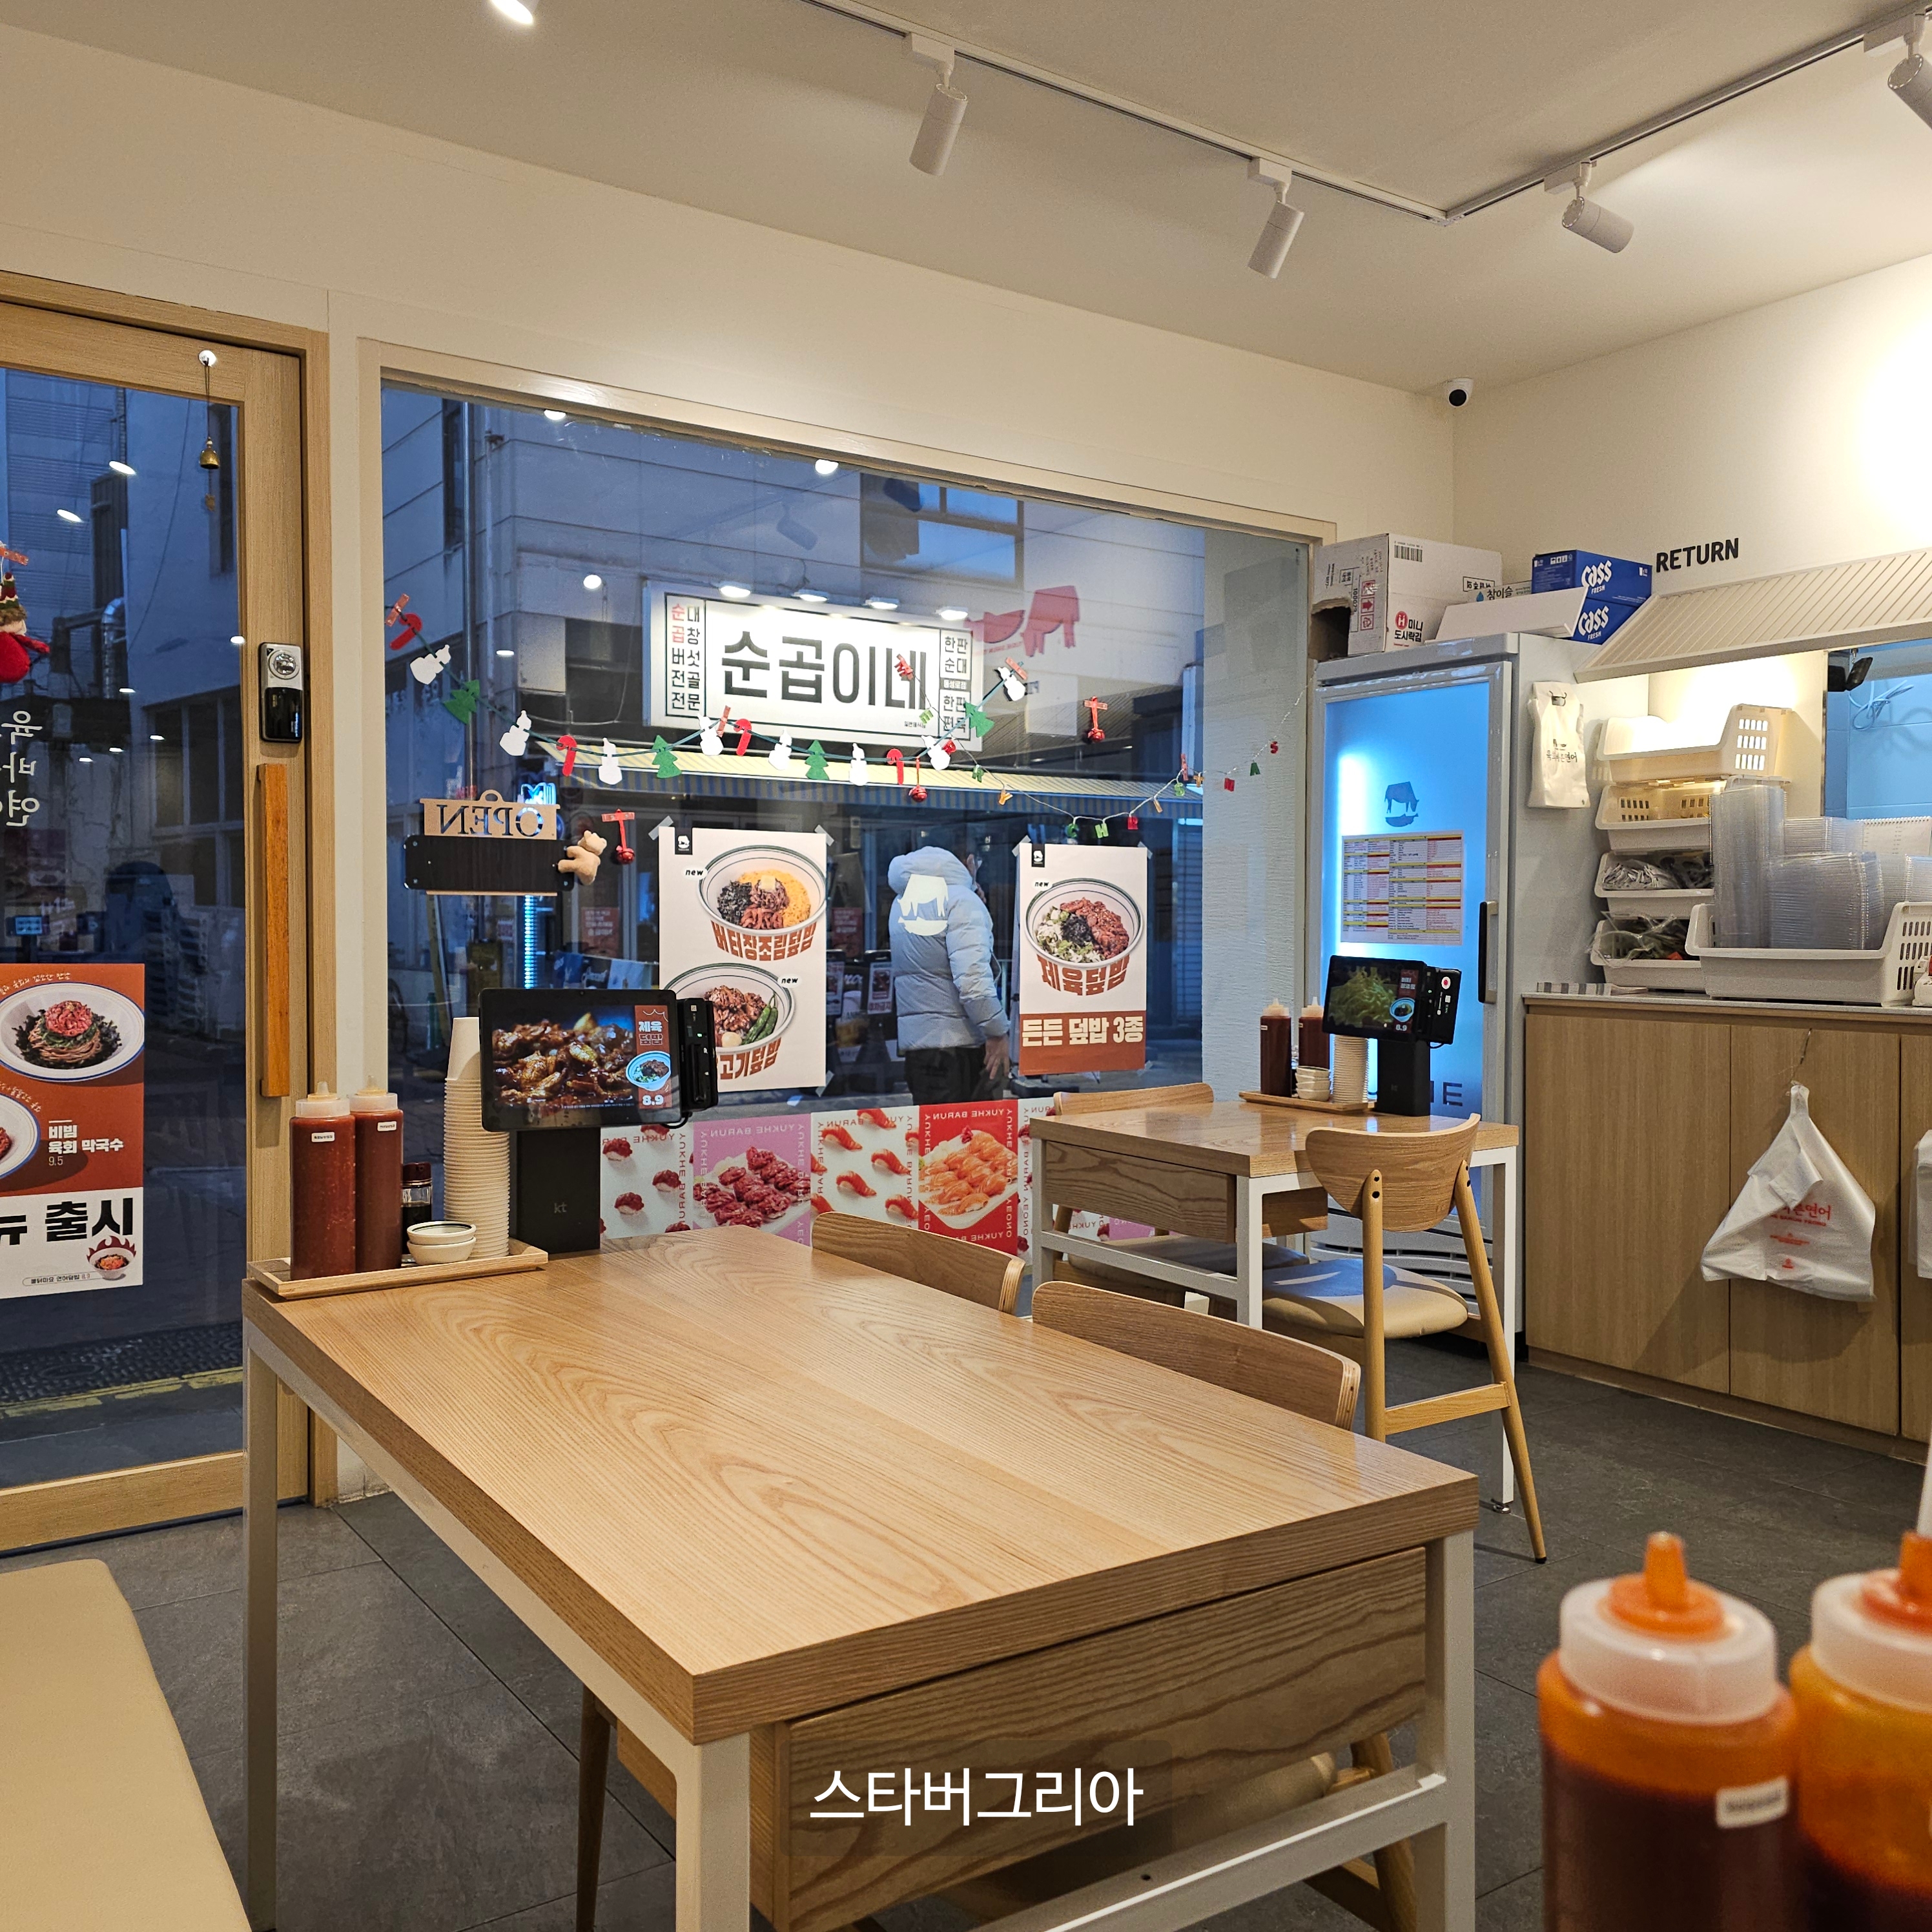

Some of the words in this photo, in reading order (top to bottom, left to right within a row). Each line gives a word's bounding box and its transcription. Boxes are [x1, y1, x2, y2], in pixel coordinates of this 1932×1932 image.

[1656, 537, 1739, 573] RETURN
[1486, 586, 1513, 600] 참이슬
[1591, 584, 1605, 595] FRESH
[672, 604, 700, 622] 순대
[1408, 619, 1423, 632] 미니
[672, 626, 700, 645] 곱창
[1395, 630, 1422, 642] 도시락김
[1587, 630, 1601, 641] FRESH
[945, 636, 968, 654] 한판
[672, 648, 700, 667] 버섯
[945, 657, 967, 673] 순대
[722, 631, 927, 710] 순곱이네
[672, 670, 700, 689] 전골
[672, 692, 700, 711] 전문
[710, 920, 817, 961] 버터장조림덮밥
[1036, 953, 1130, 996] 제육덮밥
[638, 1021, 663, 1032] 제육
[1022, 1018, 1063, 1047] 든든
[1069, 1017, 1109, 1045] 덮밥
[1113, 1016, 1143, 1043] 3종
[639, 1033, 663, 1045] 덮밥
[716, 1036, 782, 1080] 고기덮밥
[642, 1094, 664, 1105] 8.9
[48, 1125, 77, 1138] 비빔
[48, 1140, 77, 1154] 육회
[82, 1138, 124, 1153] 막국수
[48, 1156, 63, 1166] 9.5
[554, 1202, 566, 1213] kt
[45, 1198, 133, 1242] 출시
